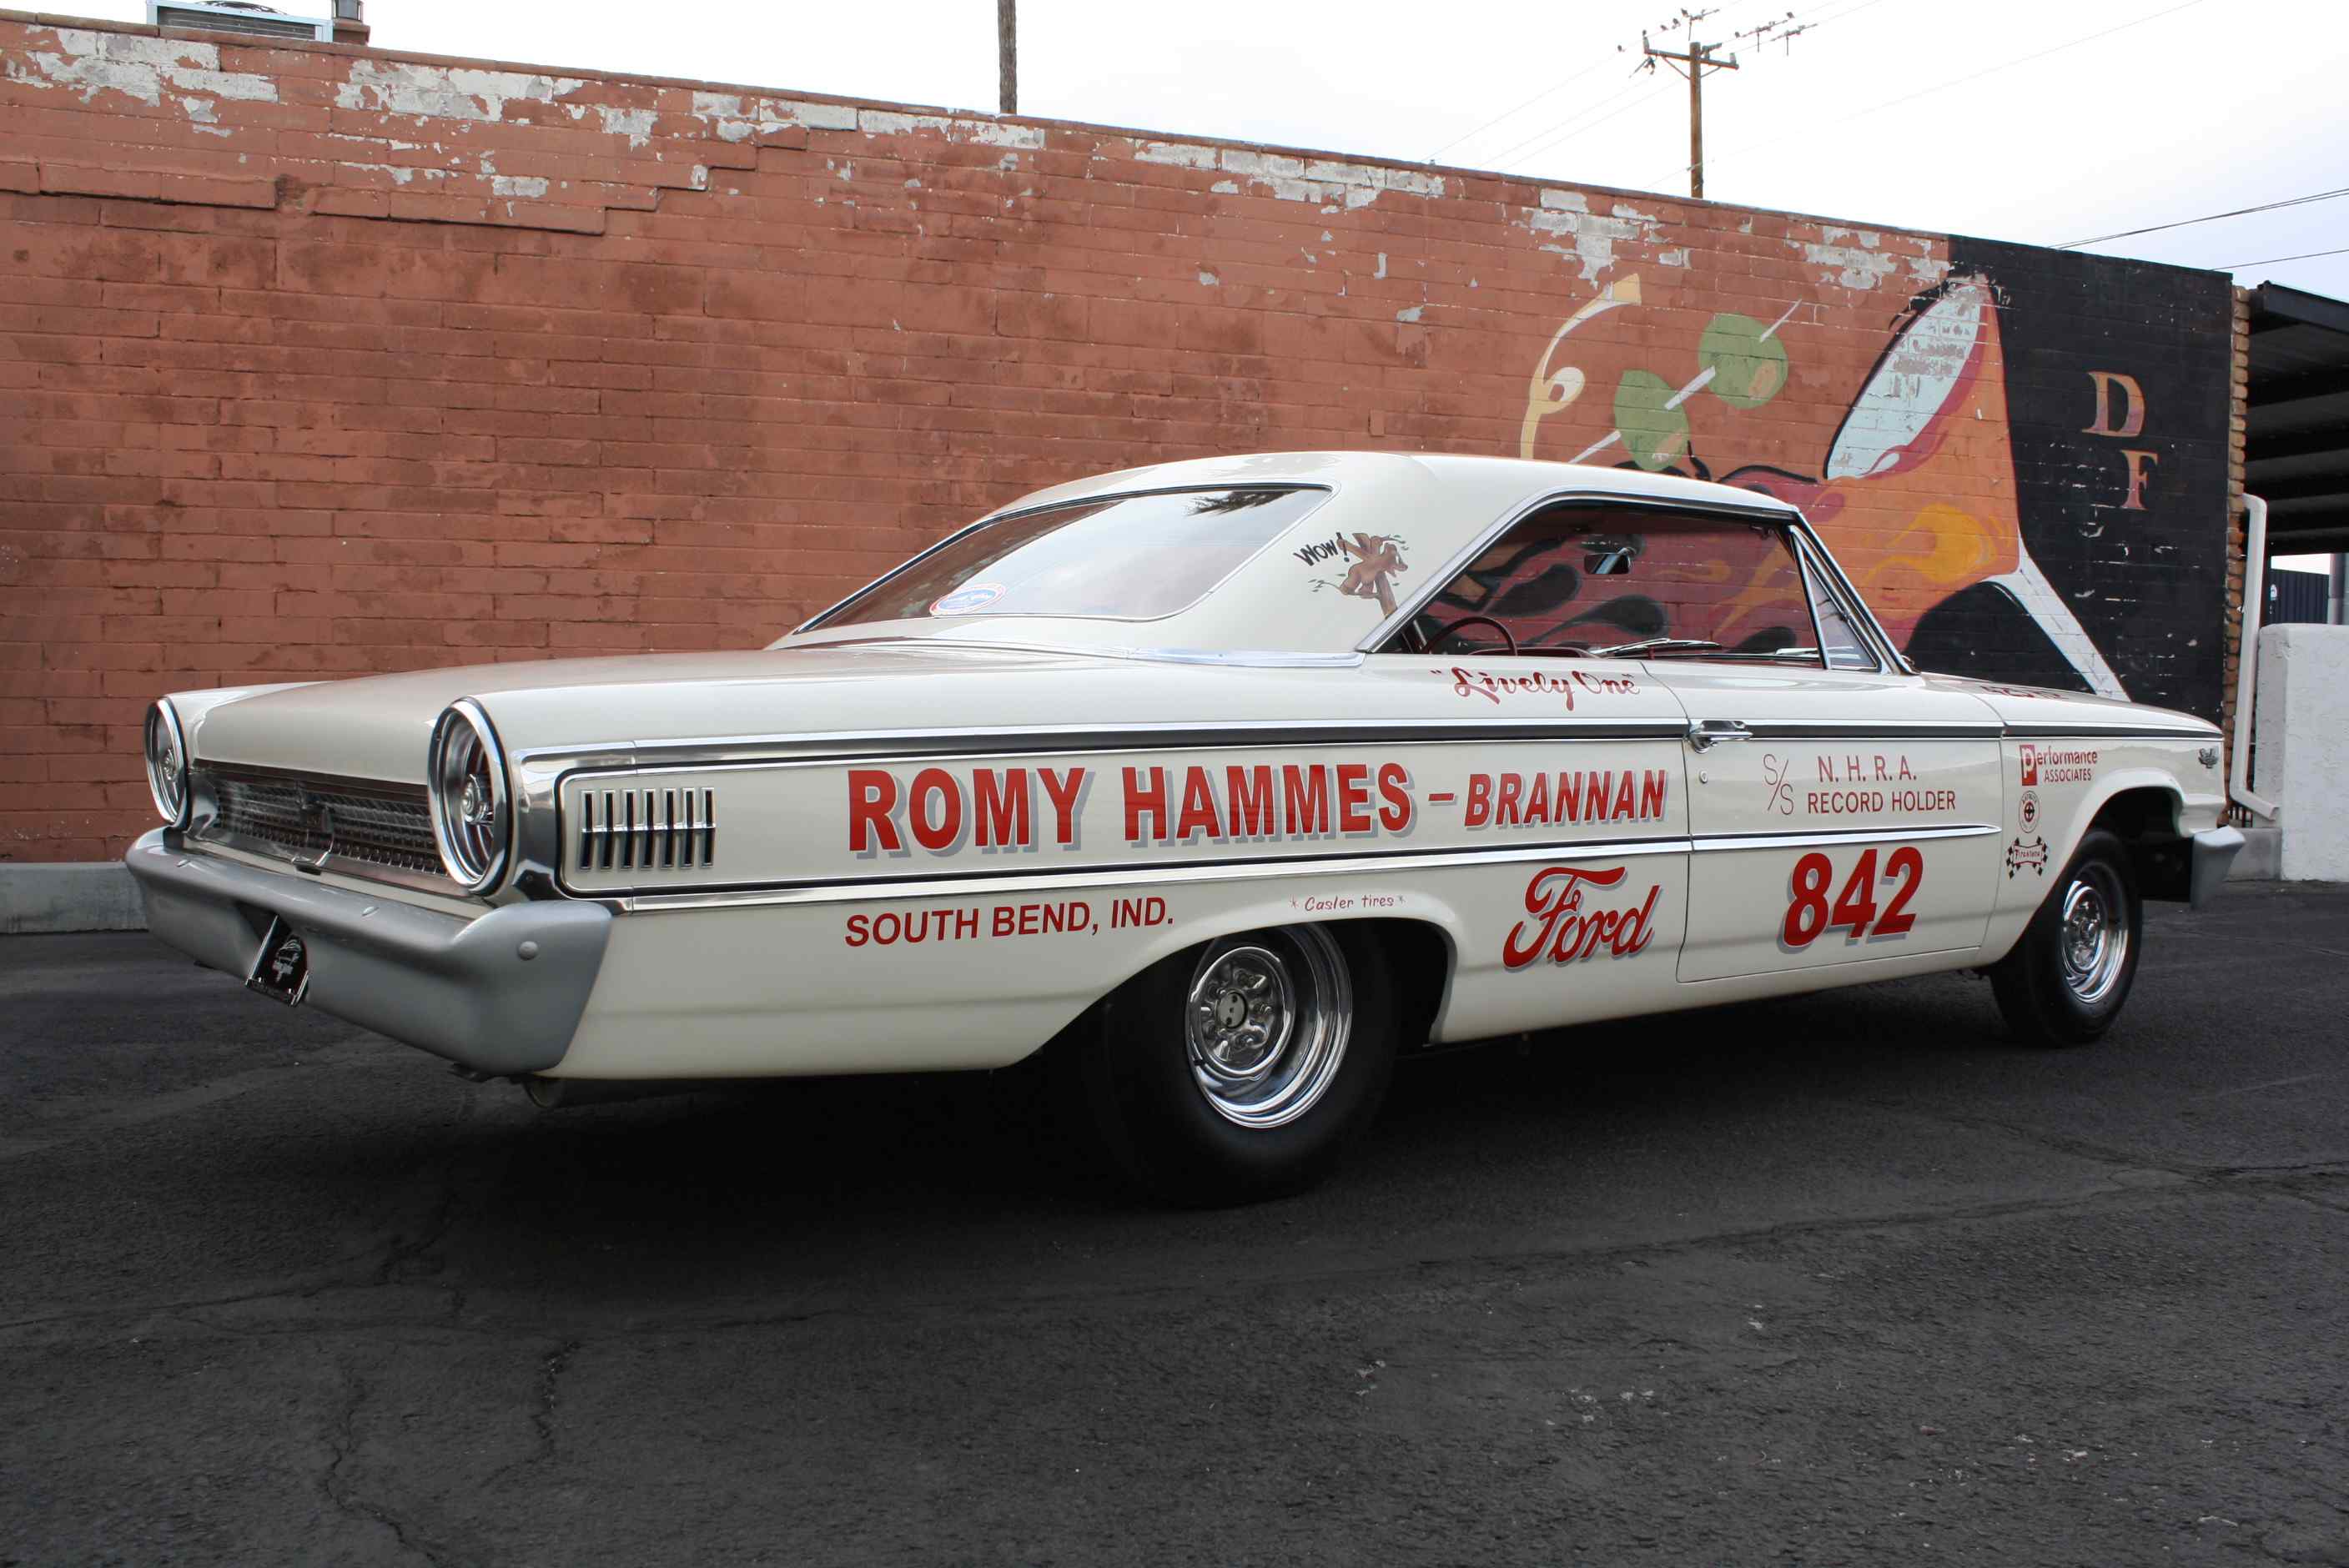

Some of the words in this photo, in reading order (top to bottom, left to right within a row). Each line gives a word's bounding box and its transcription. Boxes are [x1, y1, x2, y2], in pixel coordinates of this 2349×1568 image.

[2044, 767, 2092, 782] ASSOCIATES
[847, 767, 1094, 857] ROMY
[1121, 761, 1413, 846] HAMMES
[1464, 769, 1667, 829] BRANNAN
[1807, 791, 1884, 814] RECORD
[1891, 790, 1956, 812] HOLDER
[844, 908, 979, 947] SOUTH
[990, 901, 1099, 937] BEND,
[1110, 897, 1174, 929] IND.
[1304, 896, 1355, 912] Casler
[1502, 866, 1662, 969] Ford
[1777, 846, 1924, 954] 842
